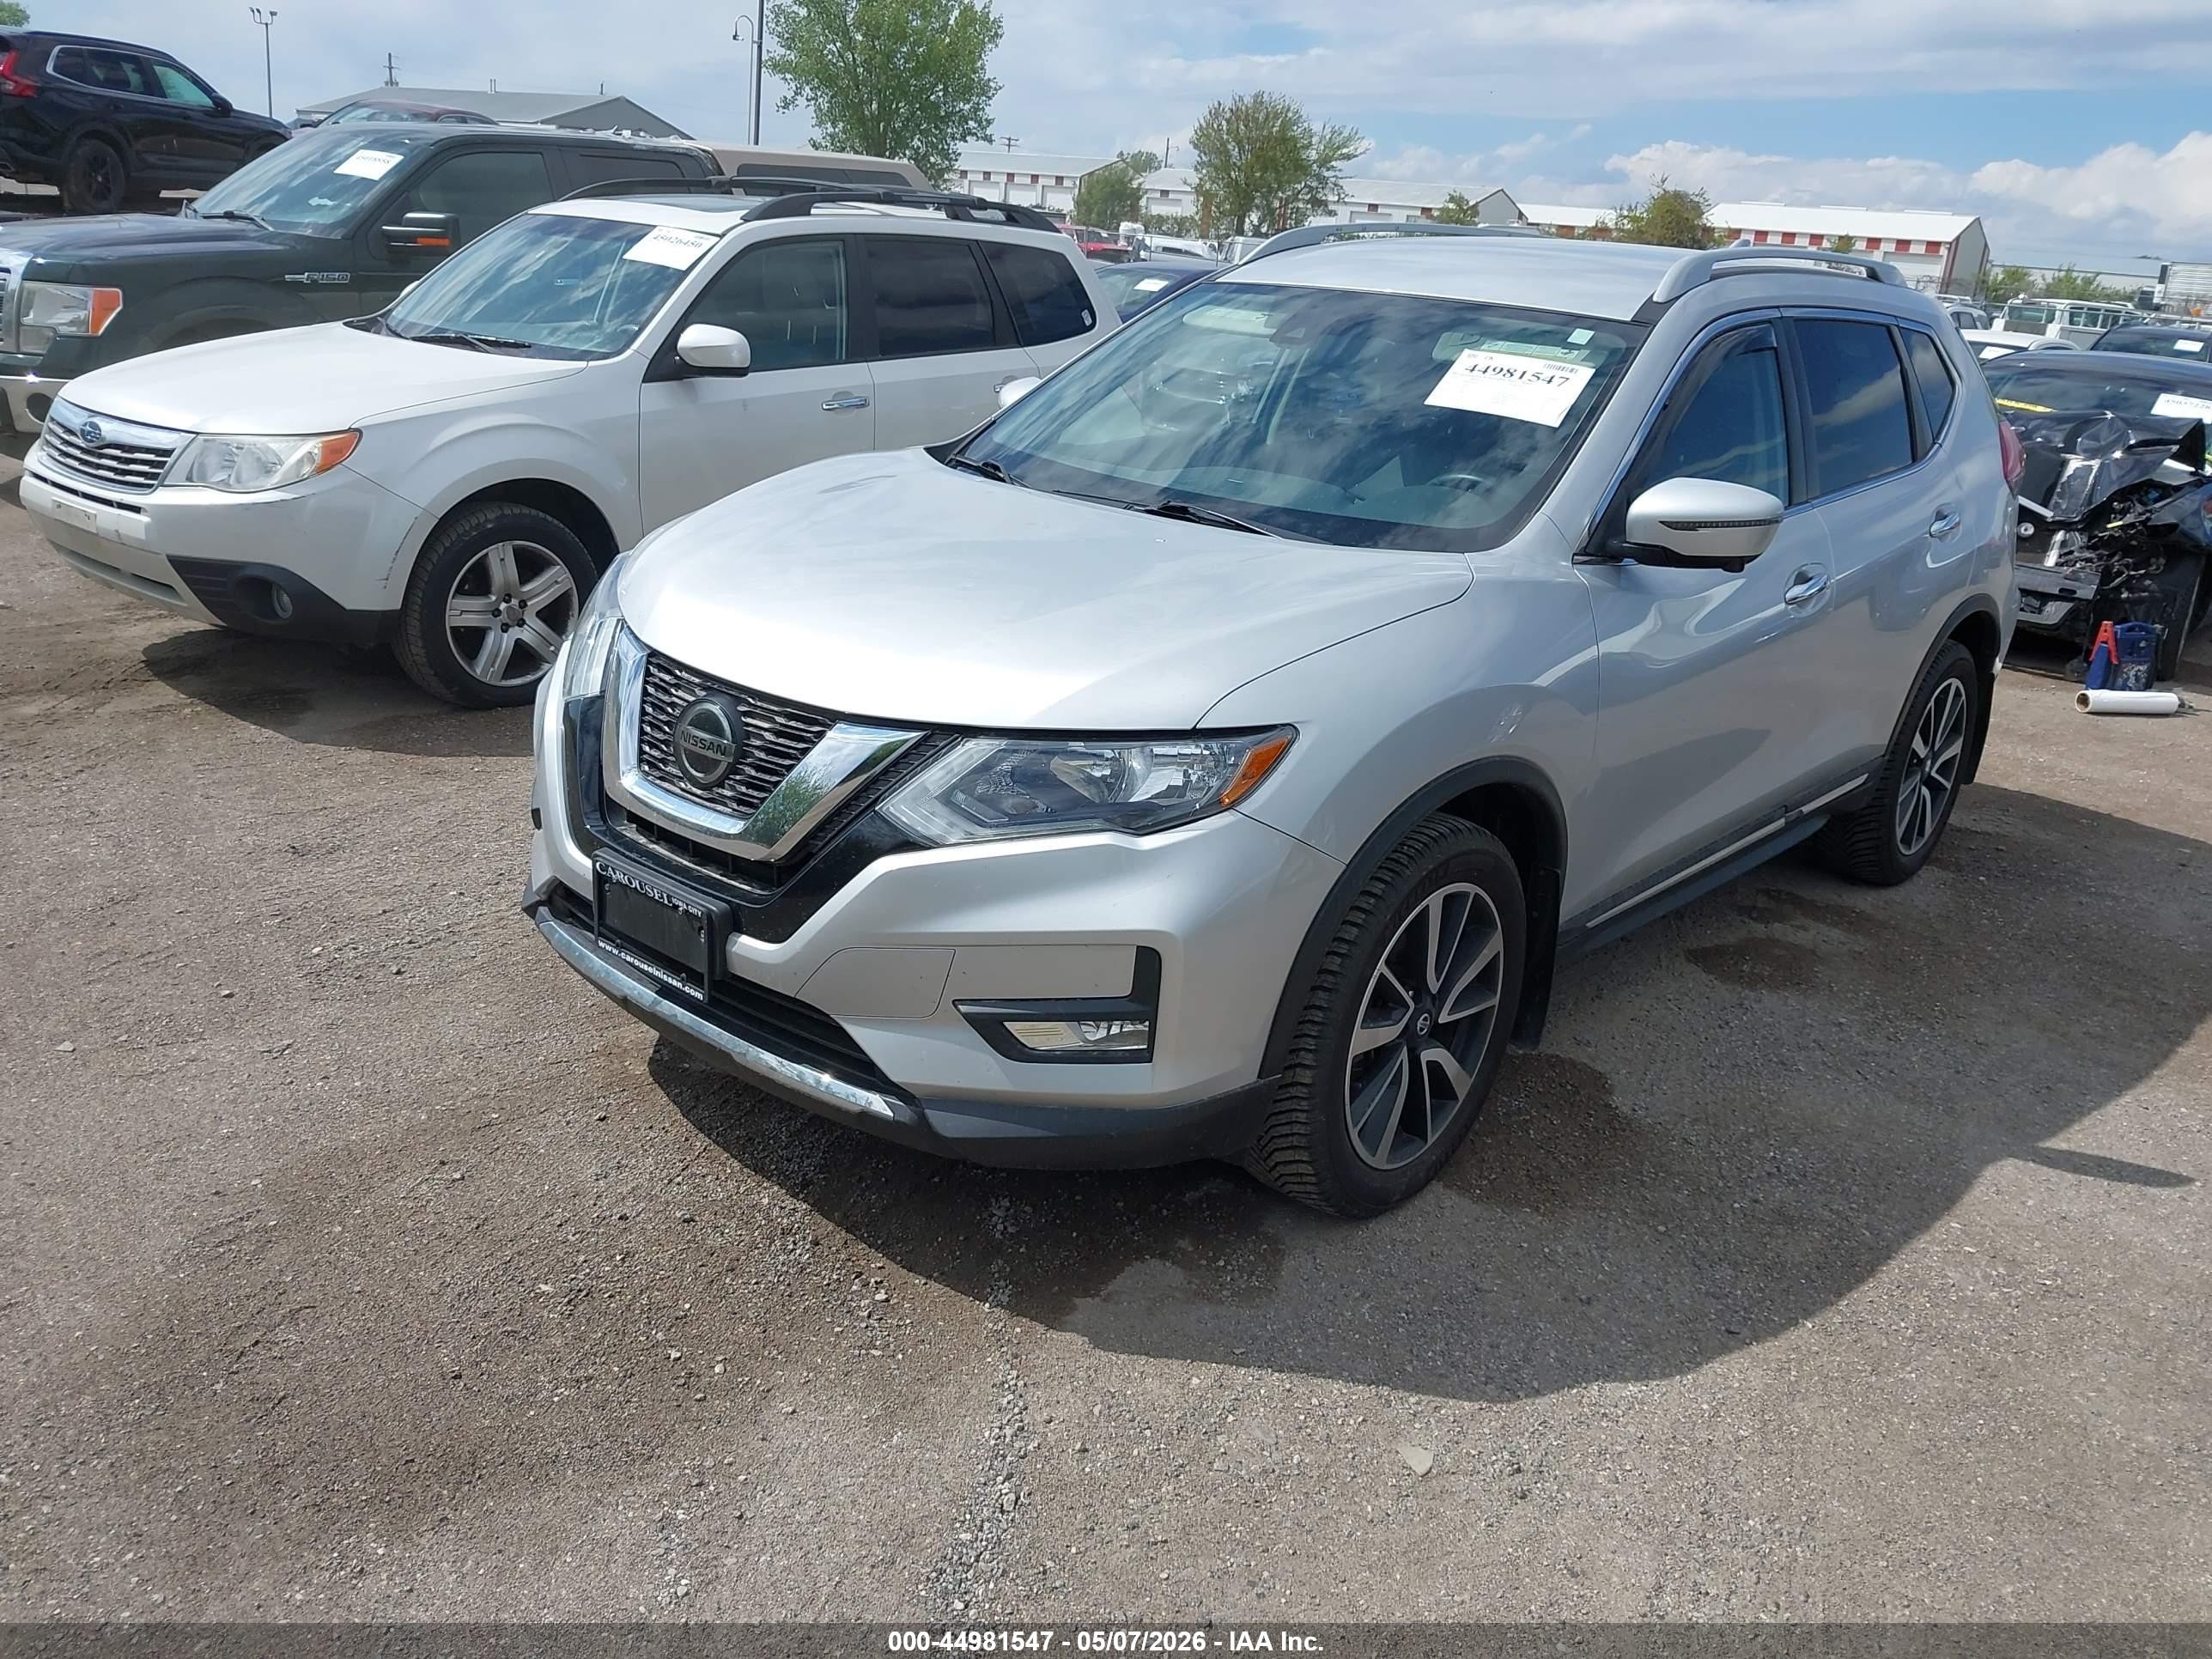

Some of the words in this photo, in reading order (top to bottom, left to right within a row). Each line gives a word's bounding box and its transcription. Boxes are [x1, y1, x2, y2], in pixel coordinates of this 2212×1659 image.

[1465, 363, 1570, 386] 44981547
[680, 731, 726, 757] NISSAN
[596, 861, 673, 907] CAROUSEL
[672, 896, 688, 910] IOWA
[688, 905, 702, 918] CITY
[598, 939, 704, 1001] www.carouselnissan.com
